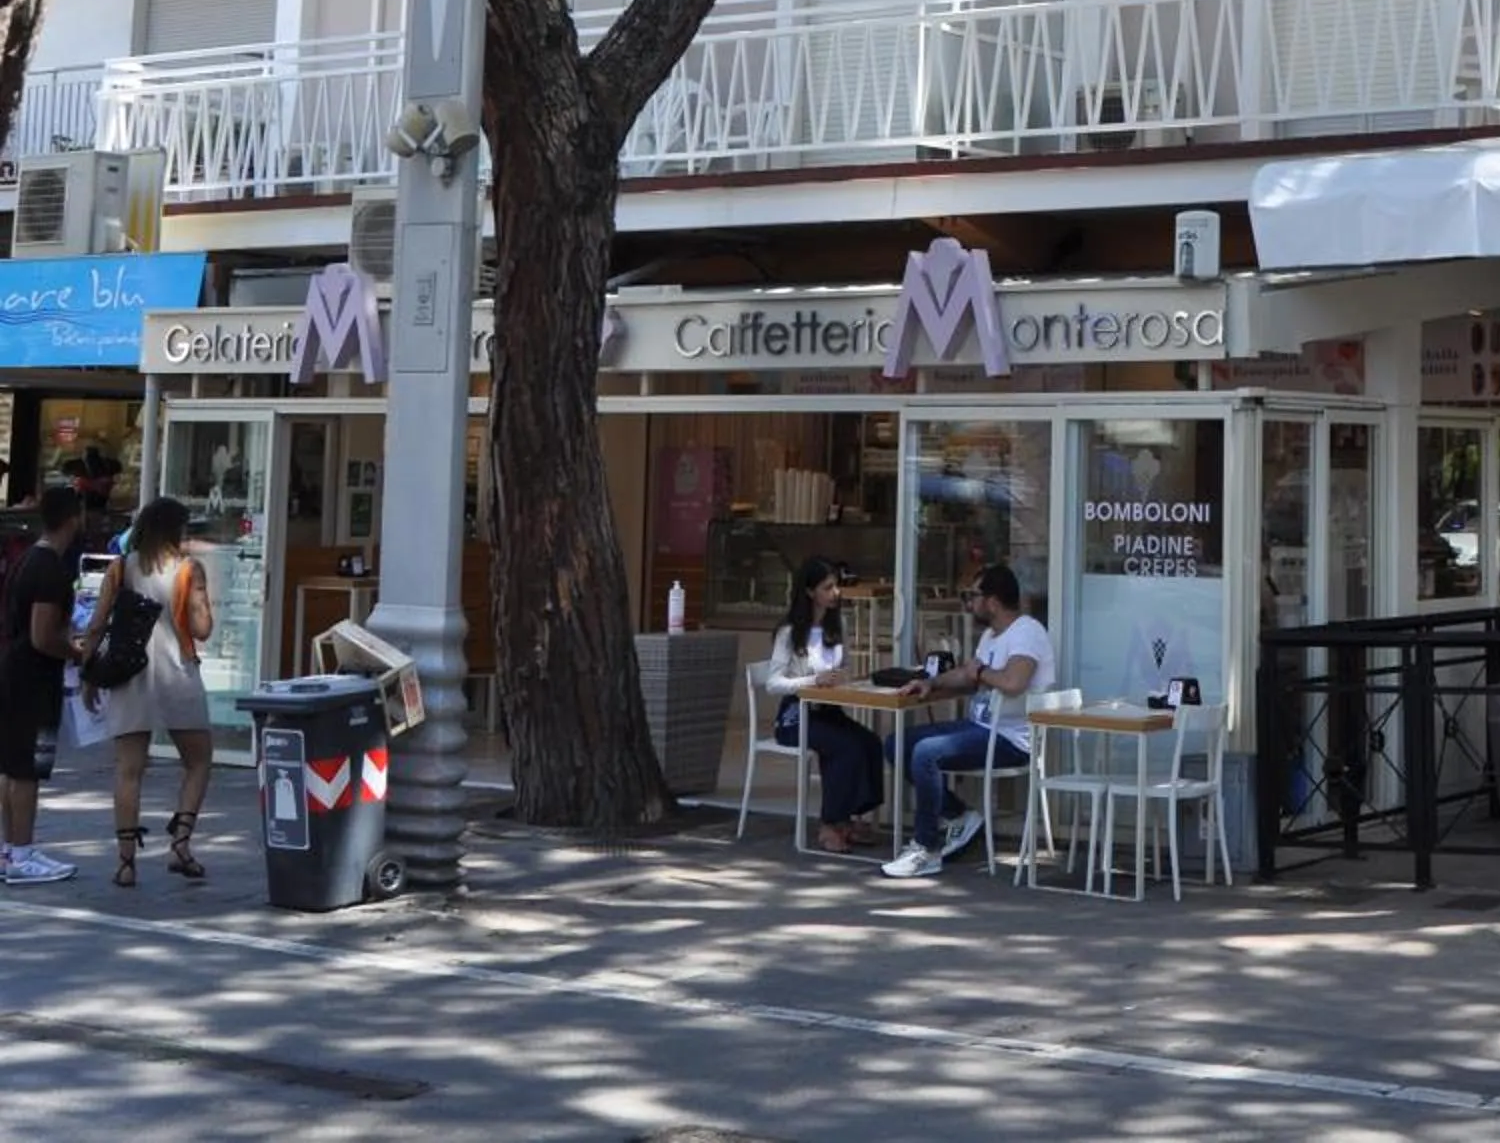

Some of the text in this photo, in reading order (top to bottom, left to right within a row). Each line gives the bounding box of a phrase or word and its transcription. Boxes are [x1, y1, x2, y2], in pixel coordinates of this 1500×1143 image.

[0, 264, 144, 310] are blu
[1084, 501, 1211, 523] BOMBOLONI
[1113, 534, 1194, 556] PIADINE
